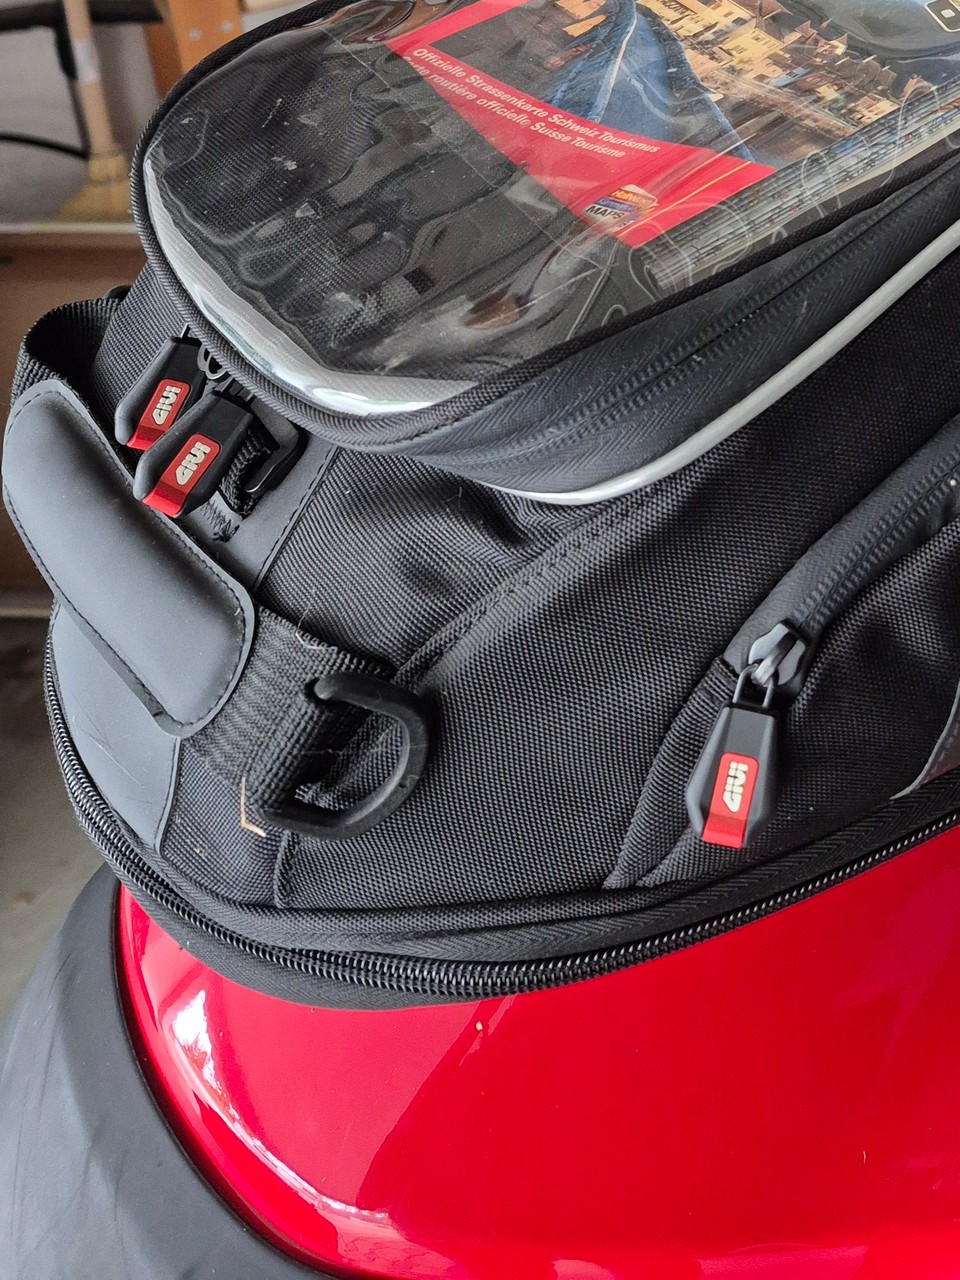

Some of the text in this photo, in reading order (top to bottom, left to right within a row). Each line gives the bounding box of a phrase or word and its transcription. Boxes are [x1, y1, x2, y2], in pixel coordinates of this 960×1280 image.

[413, 48, 661, 154] Offizielle Strassenkarte Schweiz Tourismus
[428, 74, 478, 100] routière
[476, 98, 531, 128] officielle
[530, 121, 571, 144] Suisse
[570, 136, 627, 158] Tourisme
[585, 205, 625, 220] MAPS
